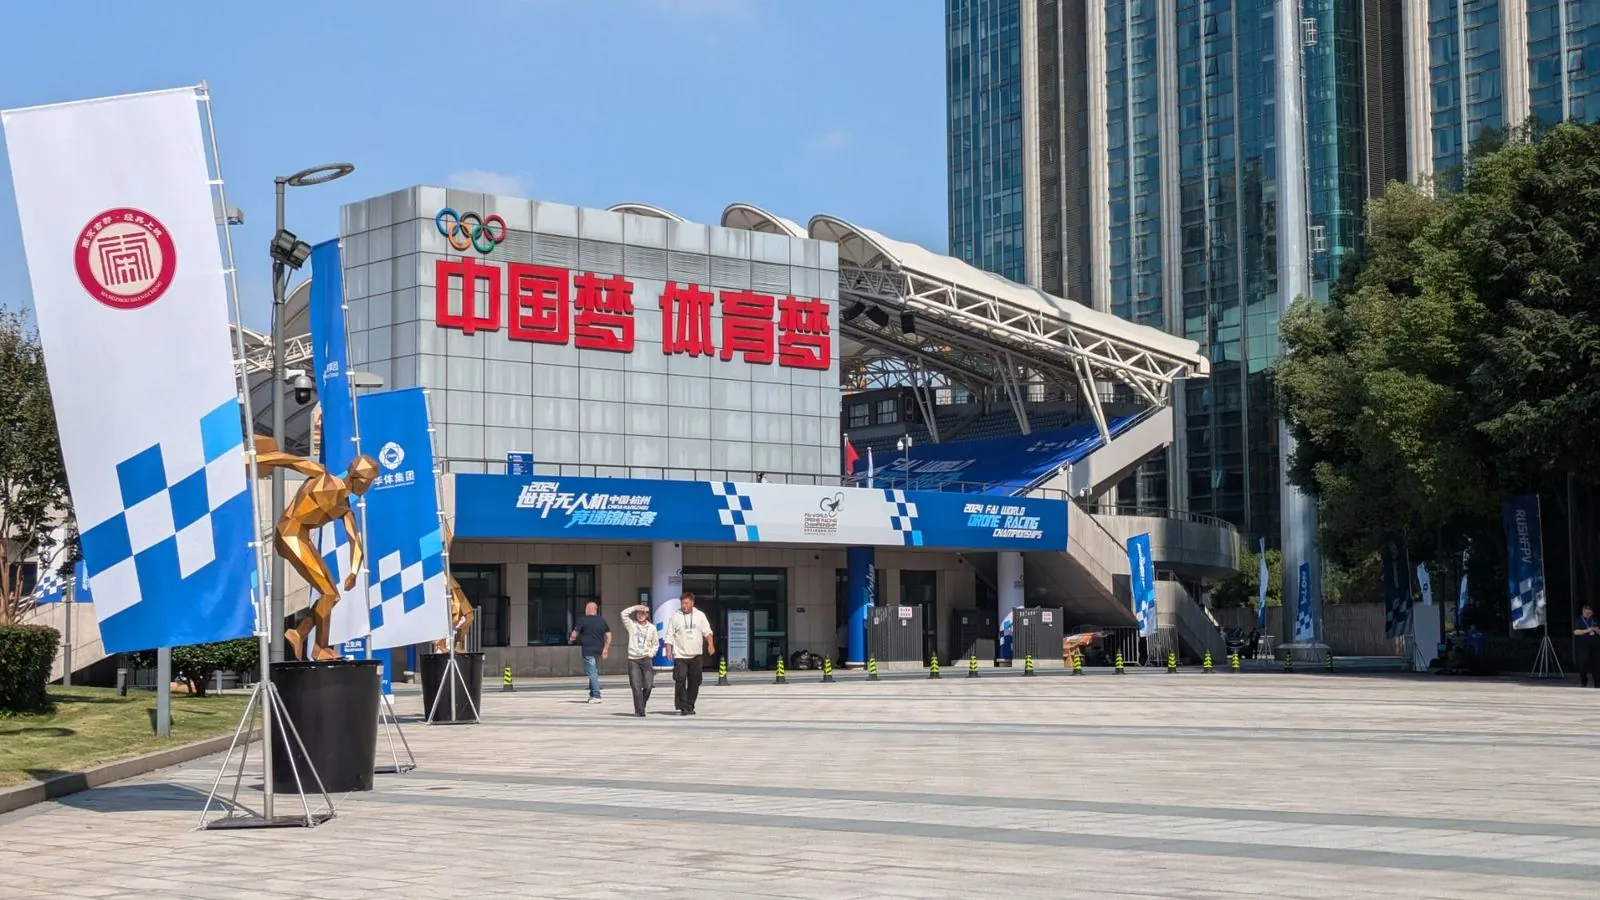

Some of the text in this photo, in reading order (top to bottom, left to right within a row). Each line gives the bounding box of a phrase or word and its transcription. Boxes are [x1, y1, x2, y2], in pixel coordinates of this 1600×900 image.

[435, 256, 831, 370] 中国梦 体育梦
[529, 482, 560, 492] 2024
[516, 485, 609, 518] 世界无人机
[963, 503, 1026, 516] 2024 FAI WORLD
[564, 510, 658, 528] 竞速锦标赛
[967, 513, 1041, 530] DRONE RACING
[992, 528, 1044, 539] CHAMPIONSHIPS
[1515, 508, 1532, 563] RUSHFPV
